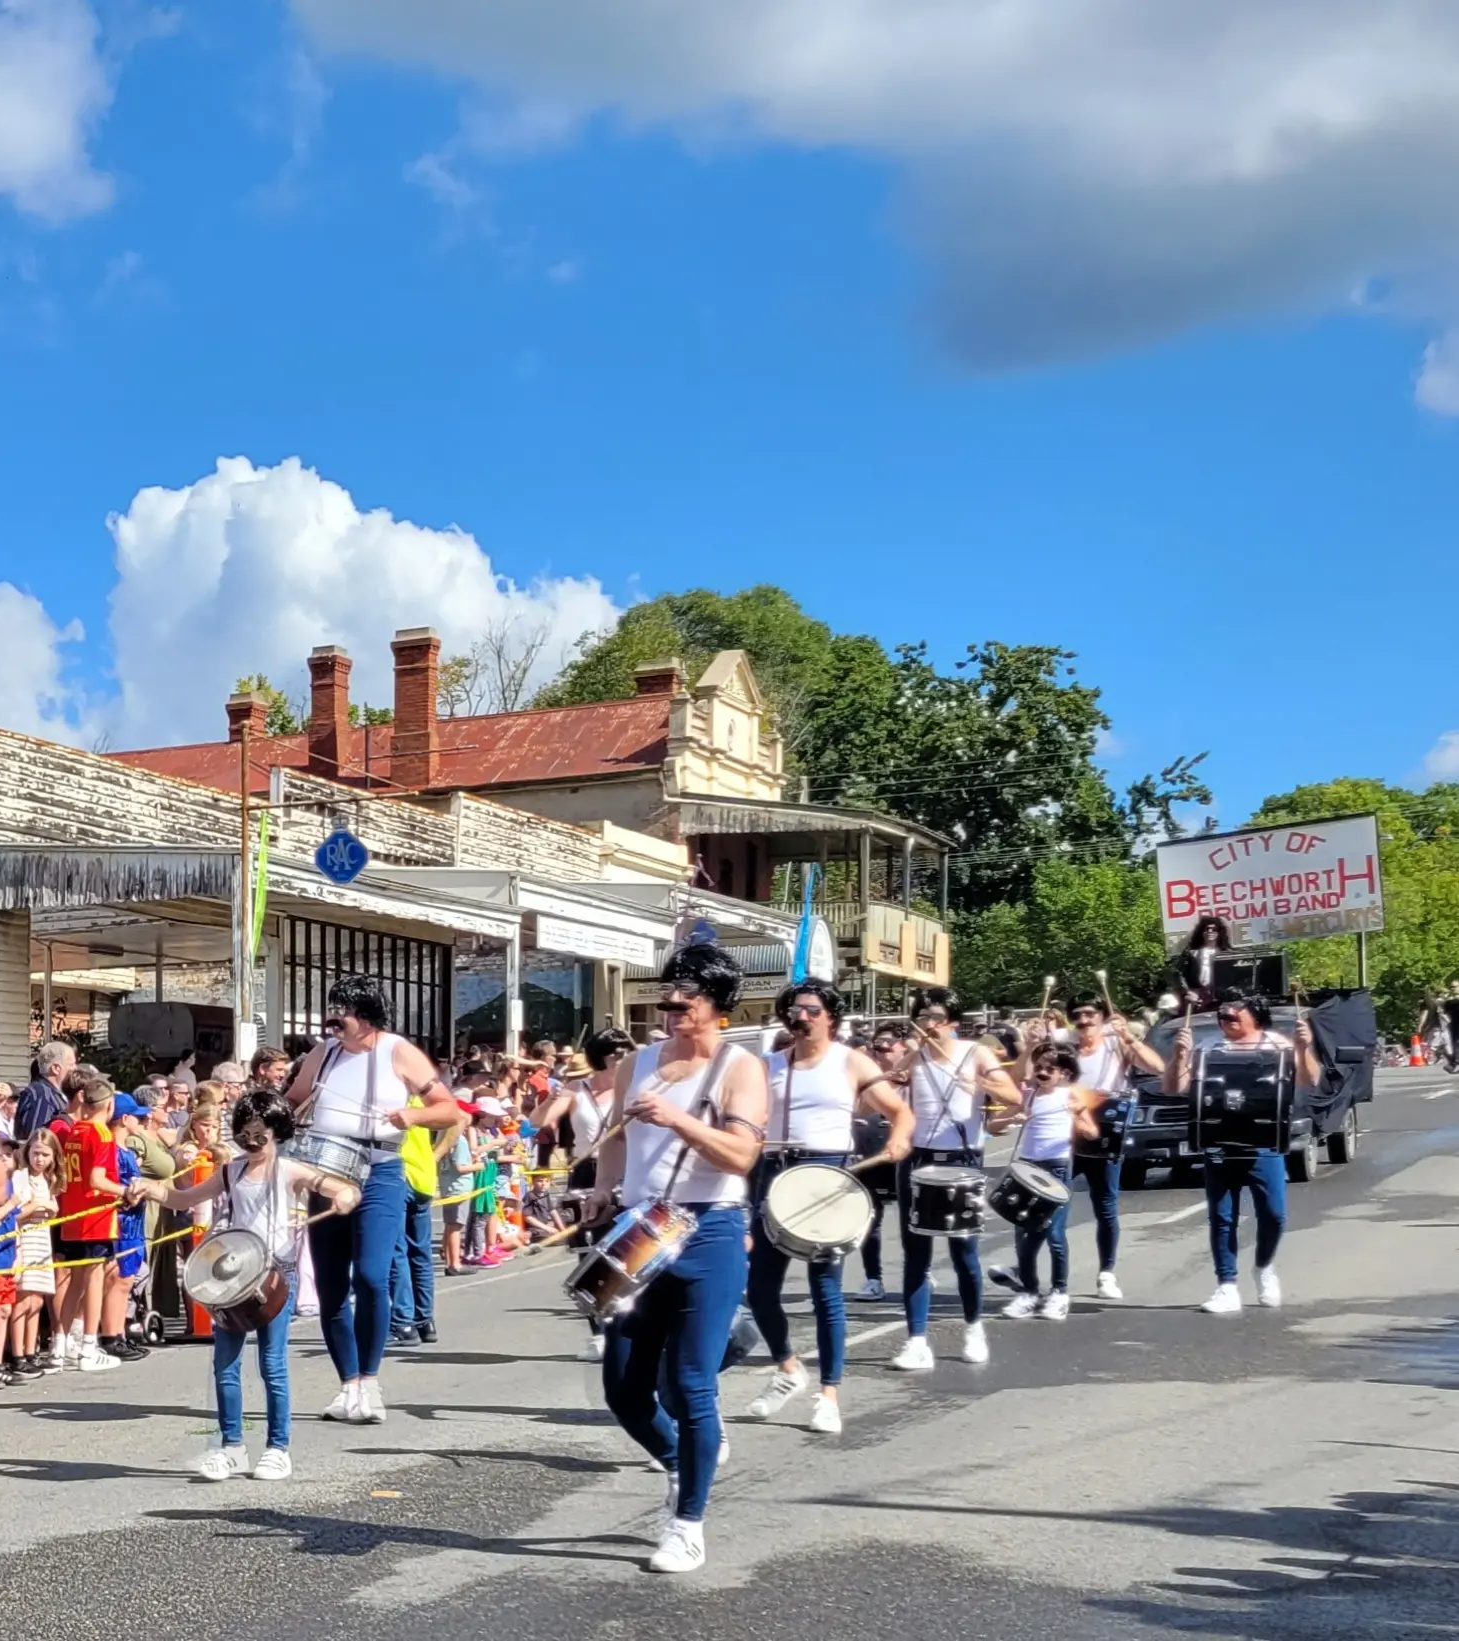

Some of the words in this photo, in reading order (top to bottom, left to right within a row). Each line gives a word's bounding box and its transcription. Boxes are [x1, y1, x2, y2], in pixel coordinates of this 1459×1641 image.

[1208, 833, 1274, 871] CITY
[1285, 832, 1327, 854] OF
[1166, 855, 1375, 919] BEECHWORTH
[1197, 902, 1268, 921] DRUM
[1273, 892, 1341, 915] BAND
[743, 980, 772, 988] DIAN
